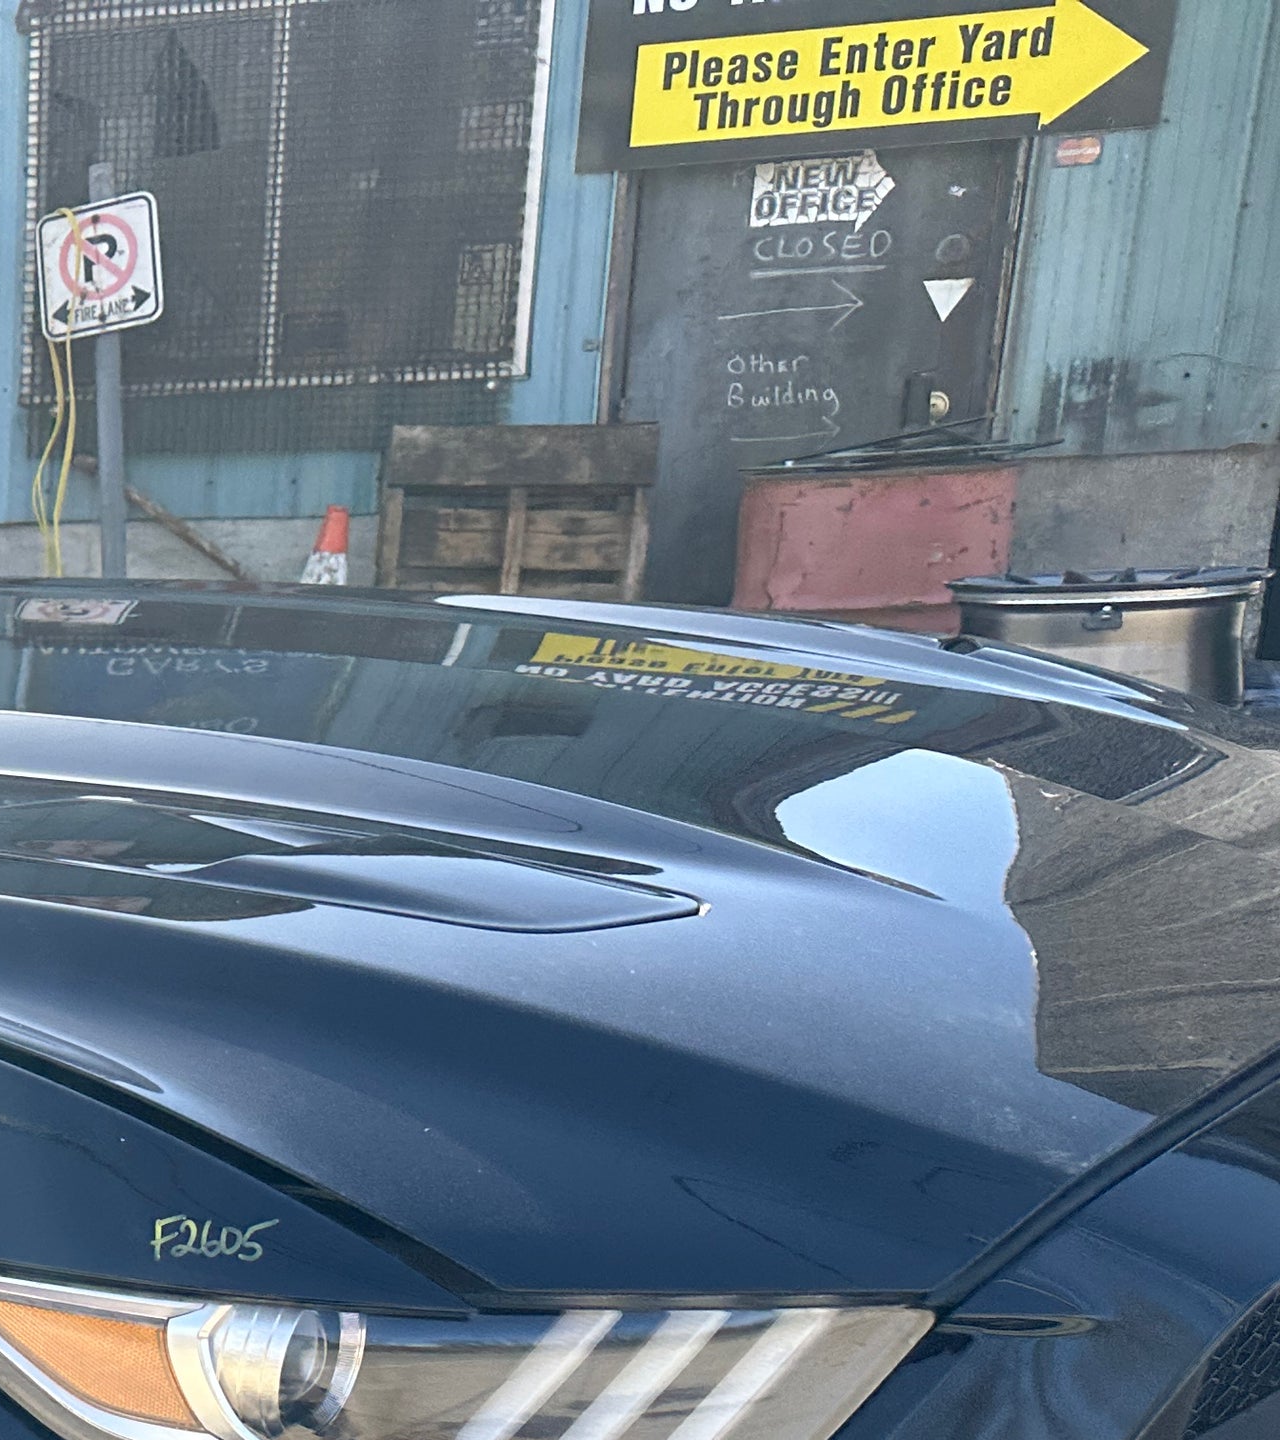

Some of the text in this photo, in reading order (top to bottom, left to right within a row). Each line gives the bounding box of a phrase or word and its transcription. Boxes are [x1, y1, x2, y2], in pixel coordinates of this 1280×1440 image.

[663, 16, 1056, 91] Please Enter Yard
[693, 70, 1013, 131] Through Office
[774, 158, 861, 191] NEW
[754, 186, 877, 221] OFFICE
[753, 229, 893, 261] CLOSED
[74, 304, 99, 323] FIRE
[727, 380, 840, 416] Building
[150, 1213, 280, 1262] F2605
